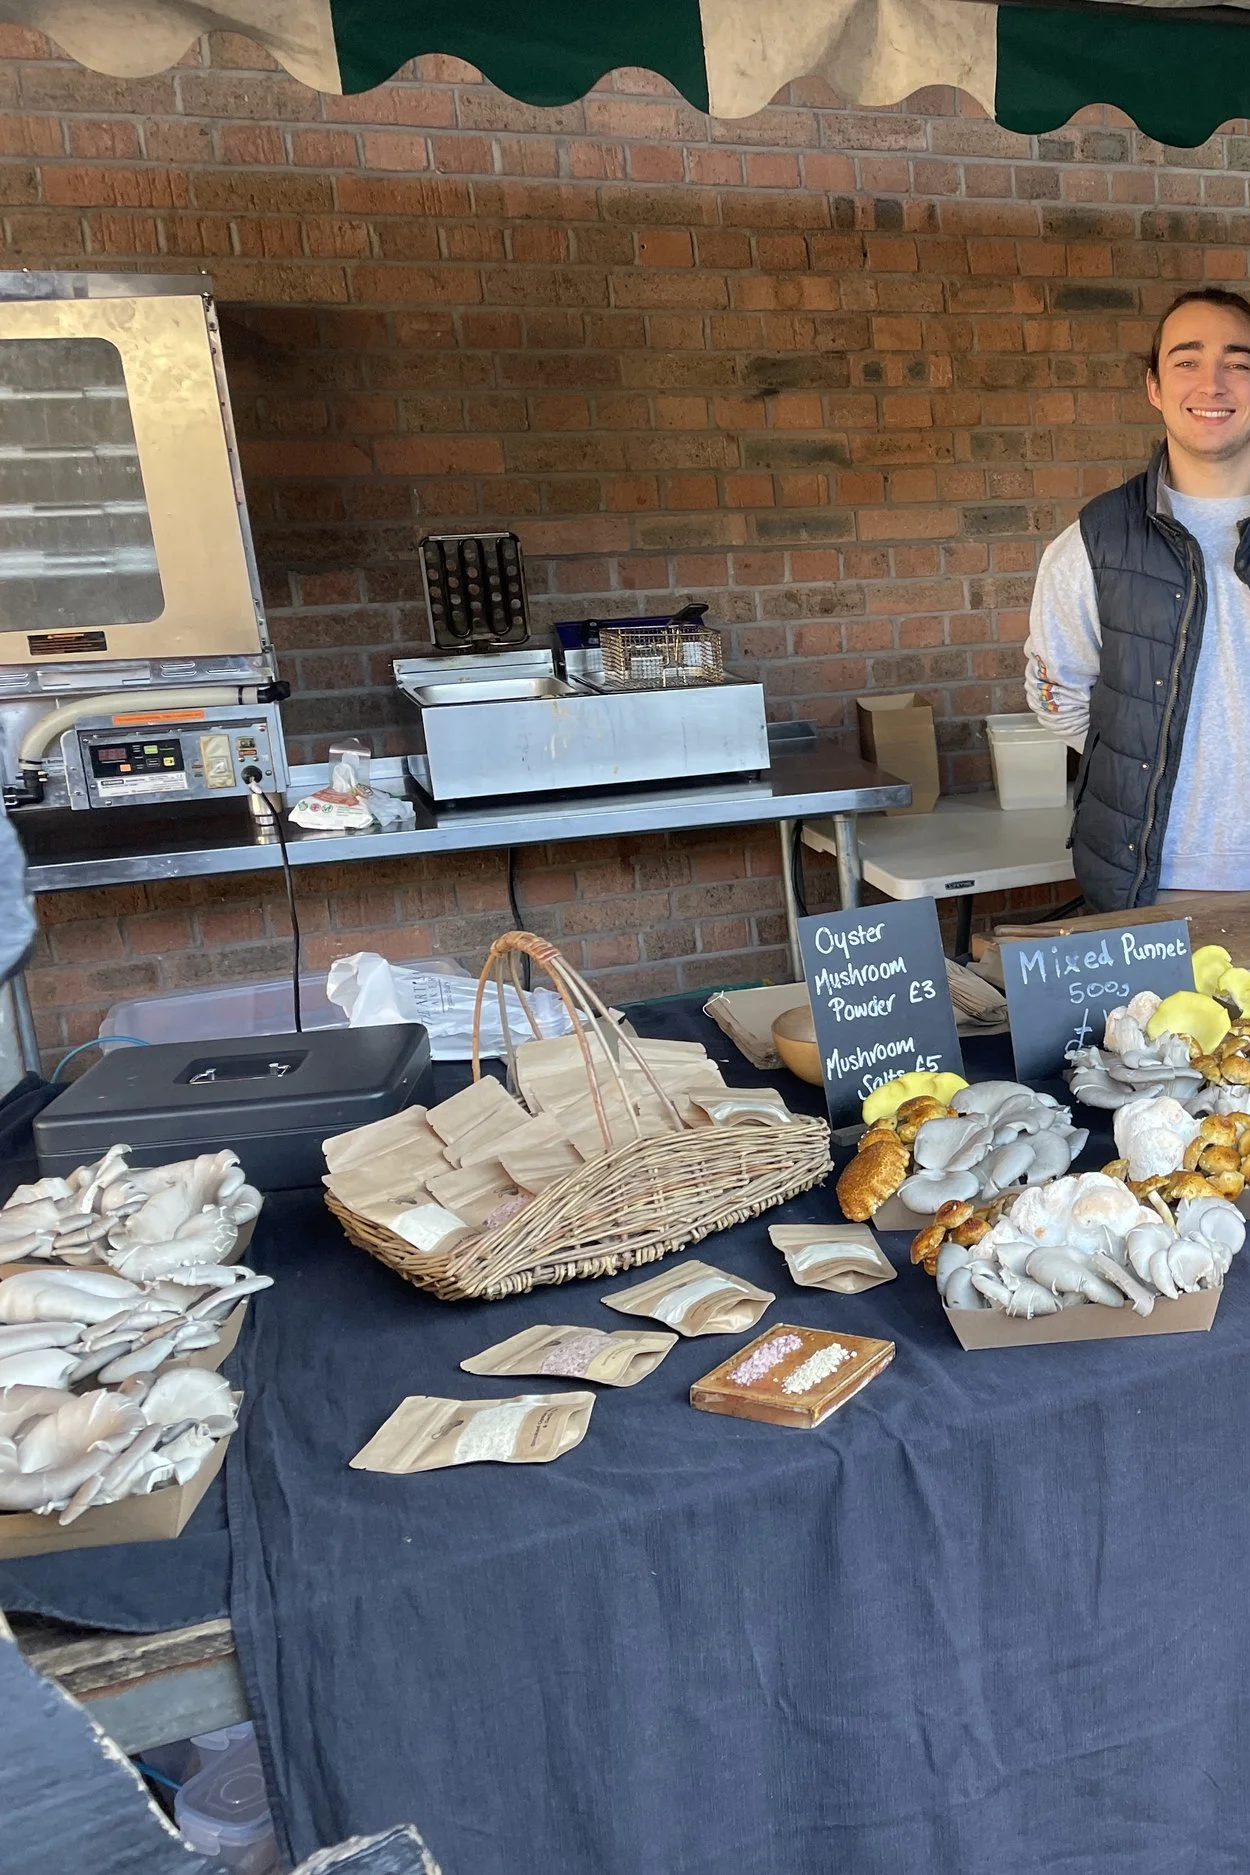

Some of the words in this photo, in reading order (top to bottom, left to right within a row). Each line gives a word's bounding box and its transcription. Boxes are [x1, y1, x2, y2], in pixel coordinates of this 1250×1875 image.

[815, 923, 885, 959] Oyster
[1018, 939, 1114, 985] Mixed
[1120, 932, 1187, 966] Punnet
[814, 956, 908, 996] Mushroom
[1068, 981, 1130, 1004] 500g
[828, 993, 896, 1022] Powder
[909, 979, 936, 1004] £3
[826, 1037, 916, 1081] Mushroom
